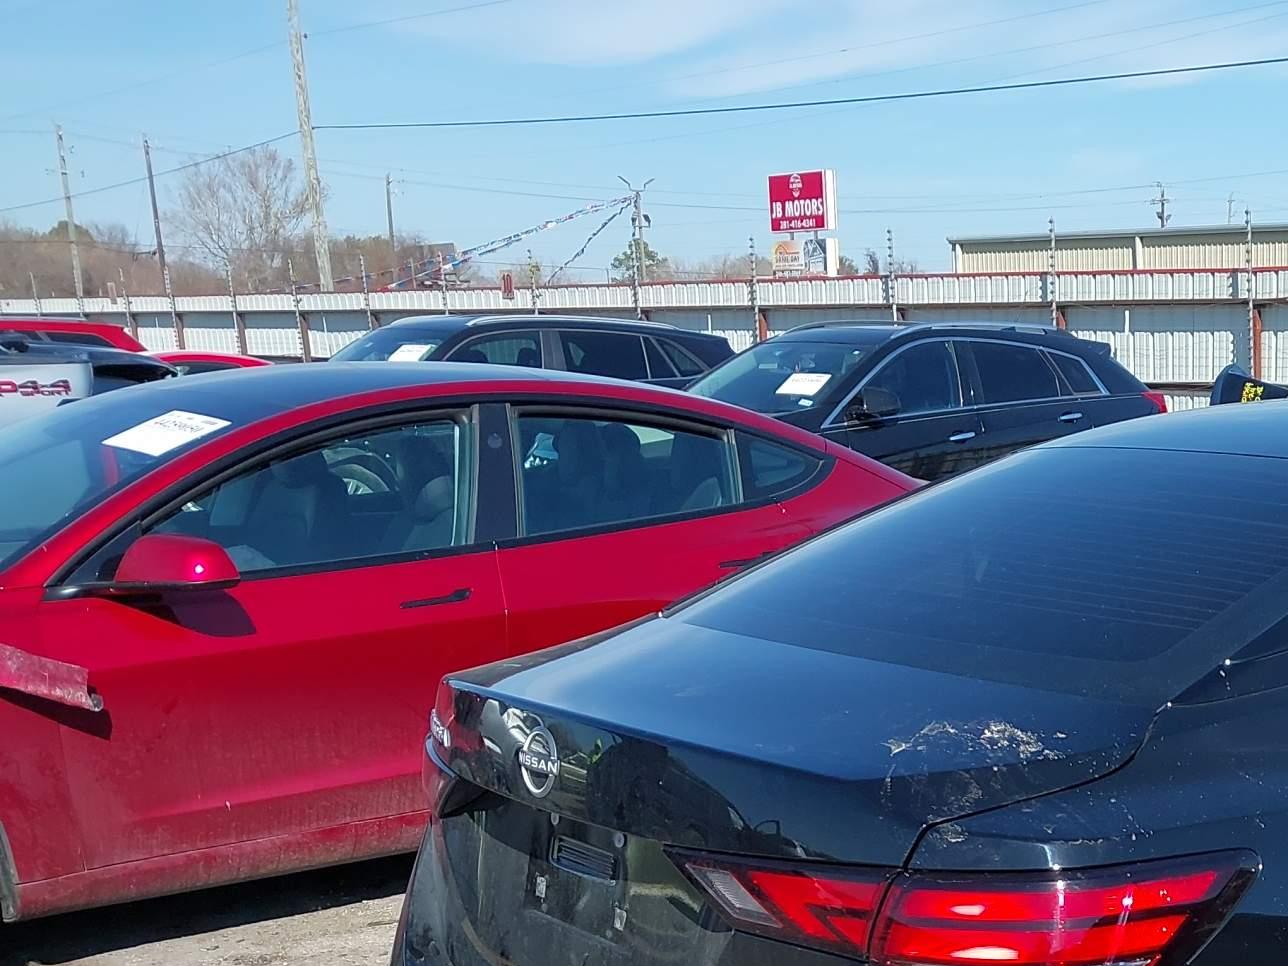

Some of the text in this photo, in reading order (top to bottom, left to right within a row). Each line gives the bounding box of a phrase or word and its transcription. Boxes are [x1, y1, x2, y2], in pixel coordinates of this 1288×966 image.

[772, 197, 824, 219] JB MOTORS
[519, 750, 560, 777] NISSAN
